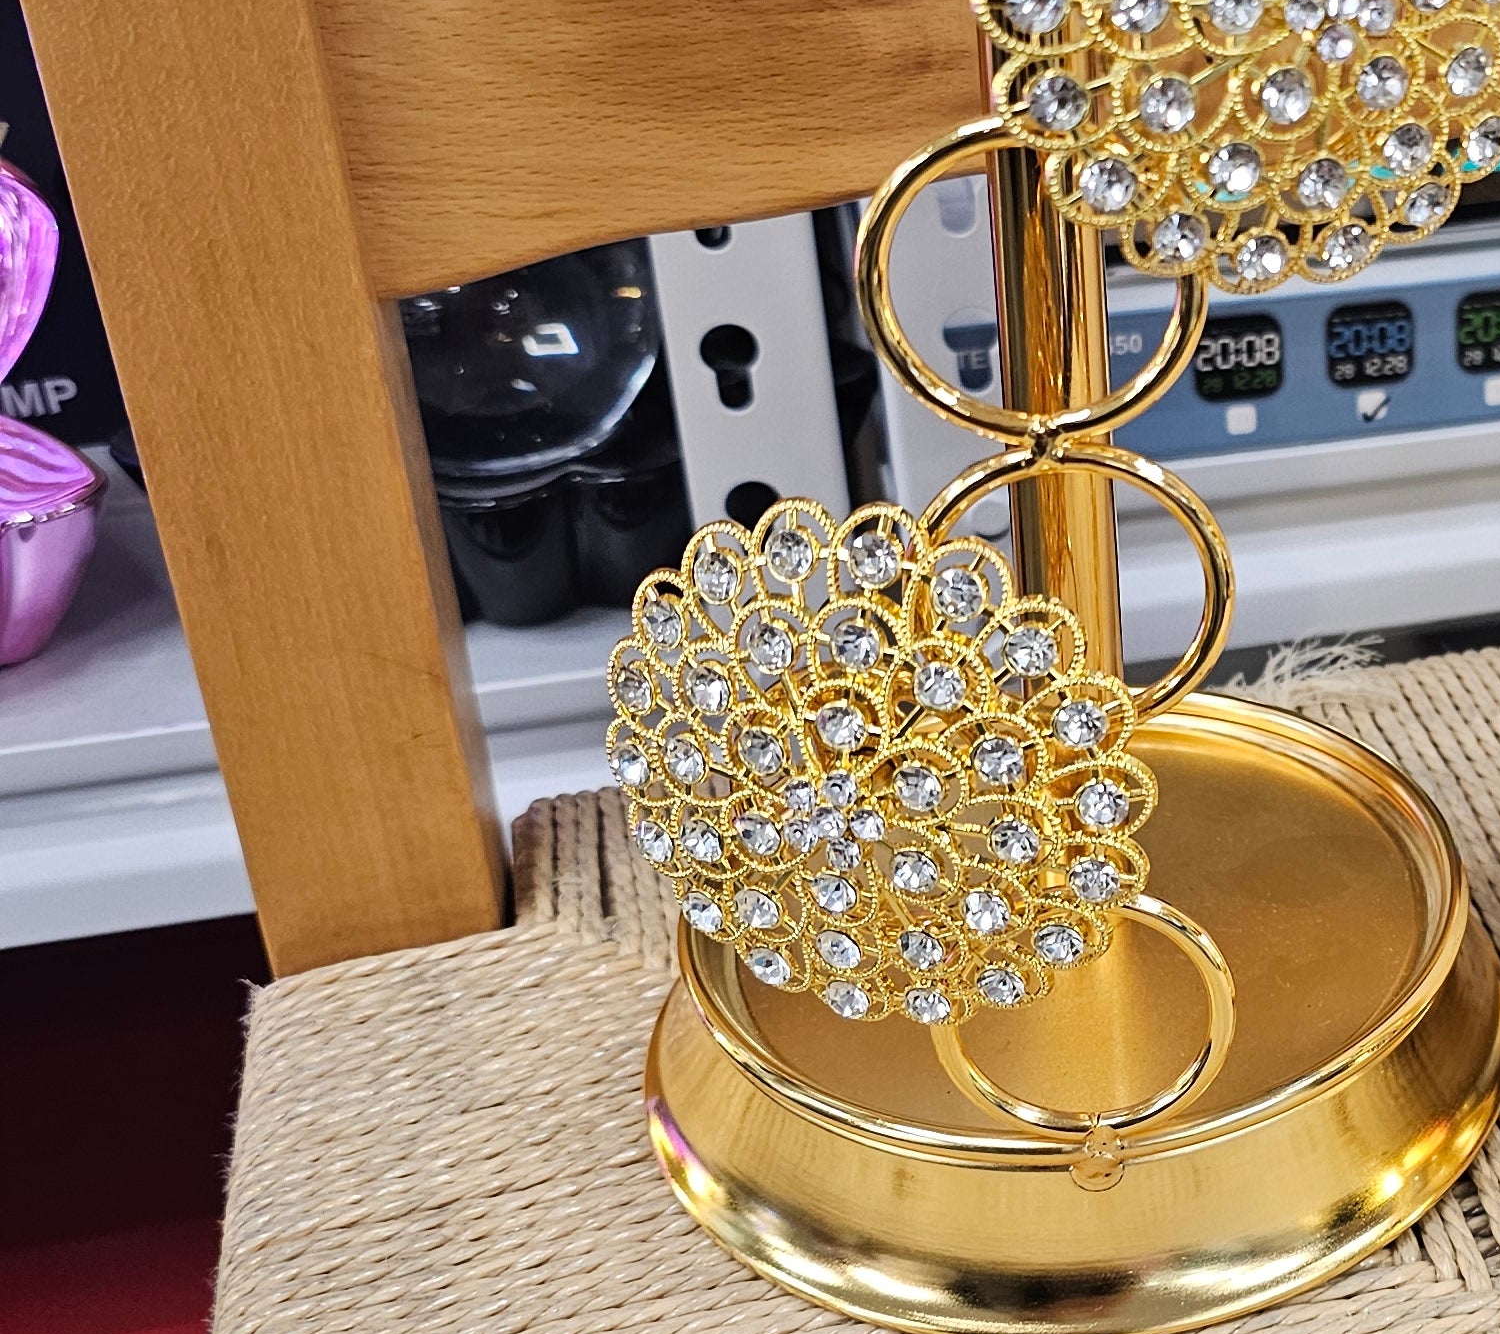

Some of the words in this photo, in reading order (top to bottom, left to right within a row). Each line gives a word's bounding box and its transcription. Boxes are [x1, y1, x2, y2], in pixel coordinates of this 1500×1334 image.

[1110, 334, 1144, 356] 50
[1197, 334, 1280, 373] 20:08
[1328, 320, 1412, 358] 20:08
